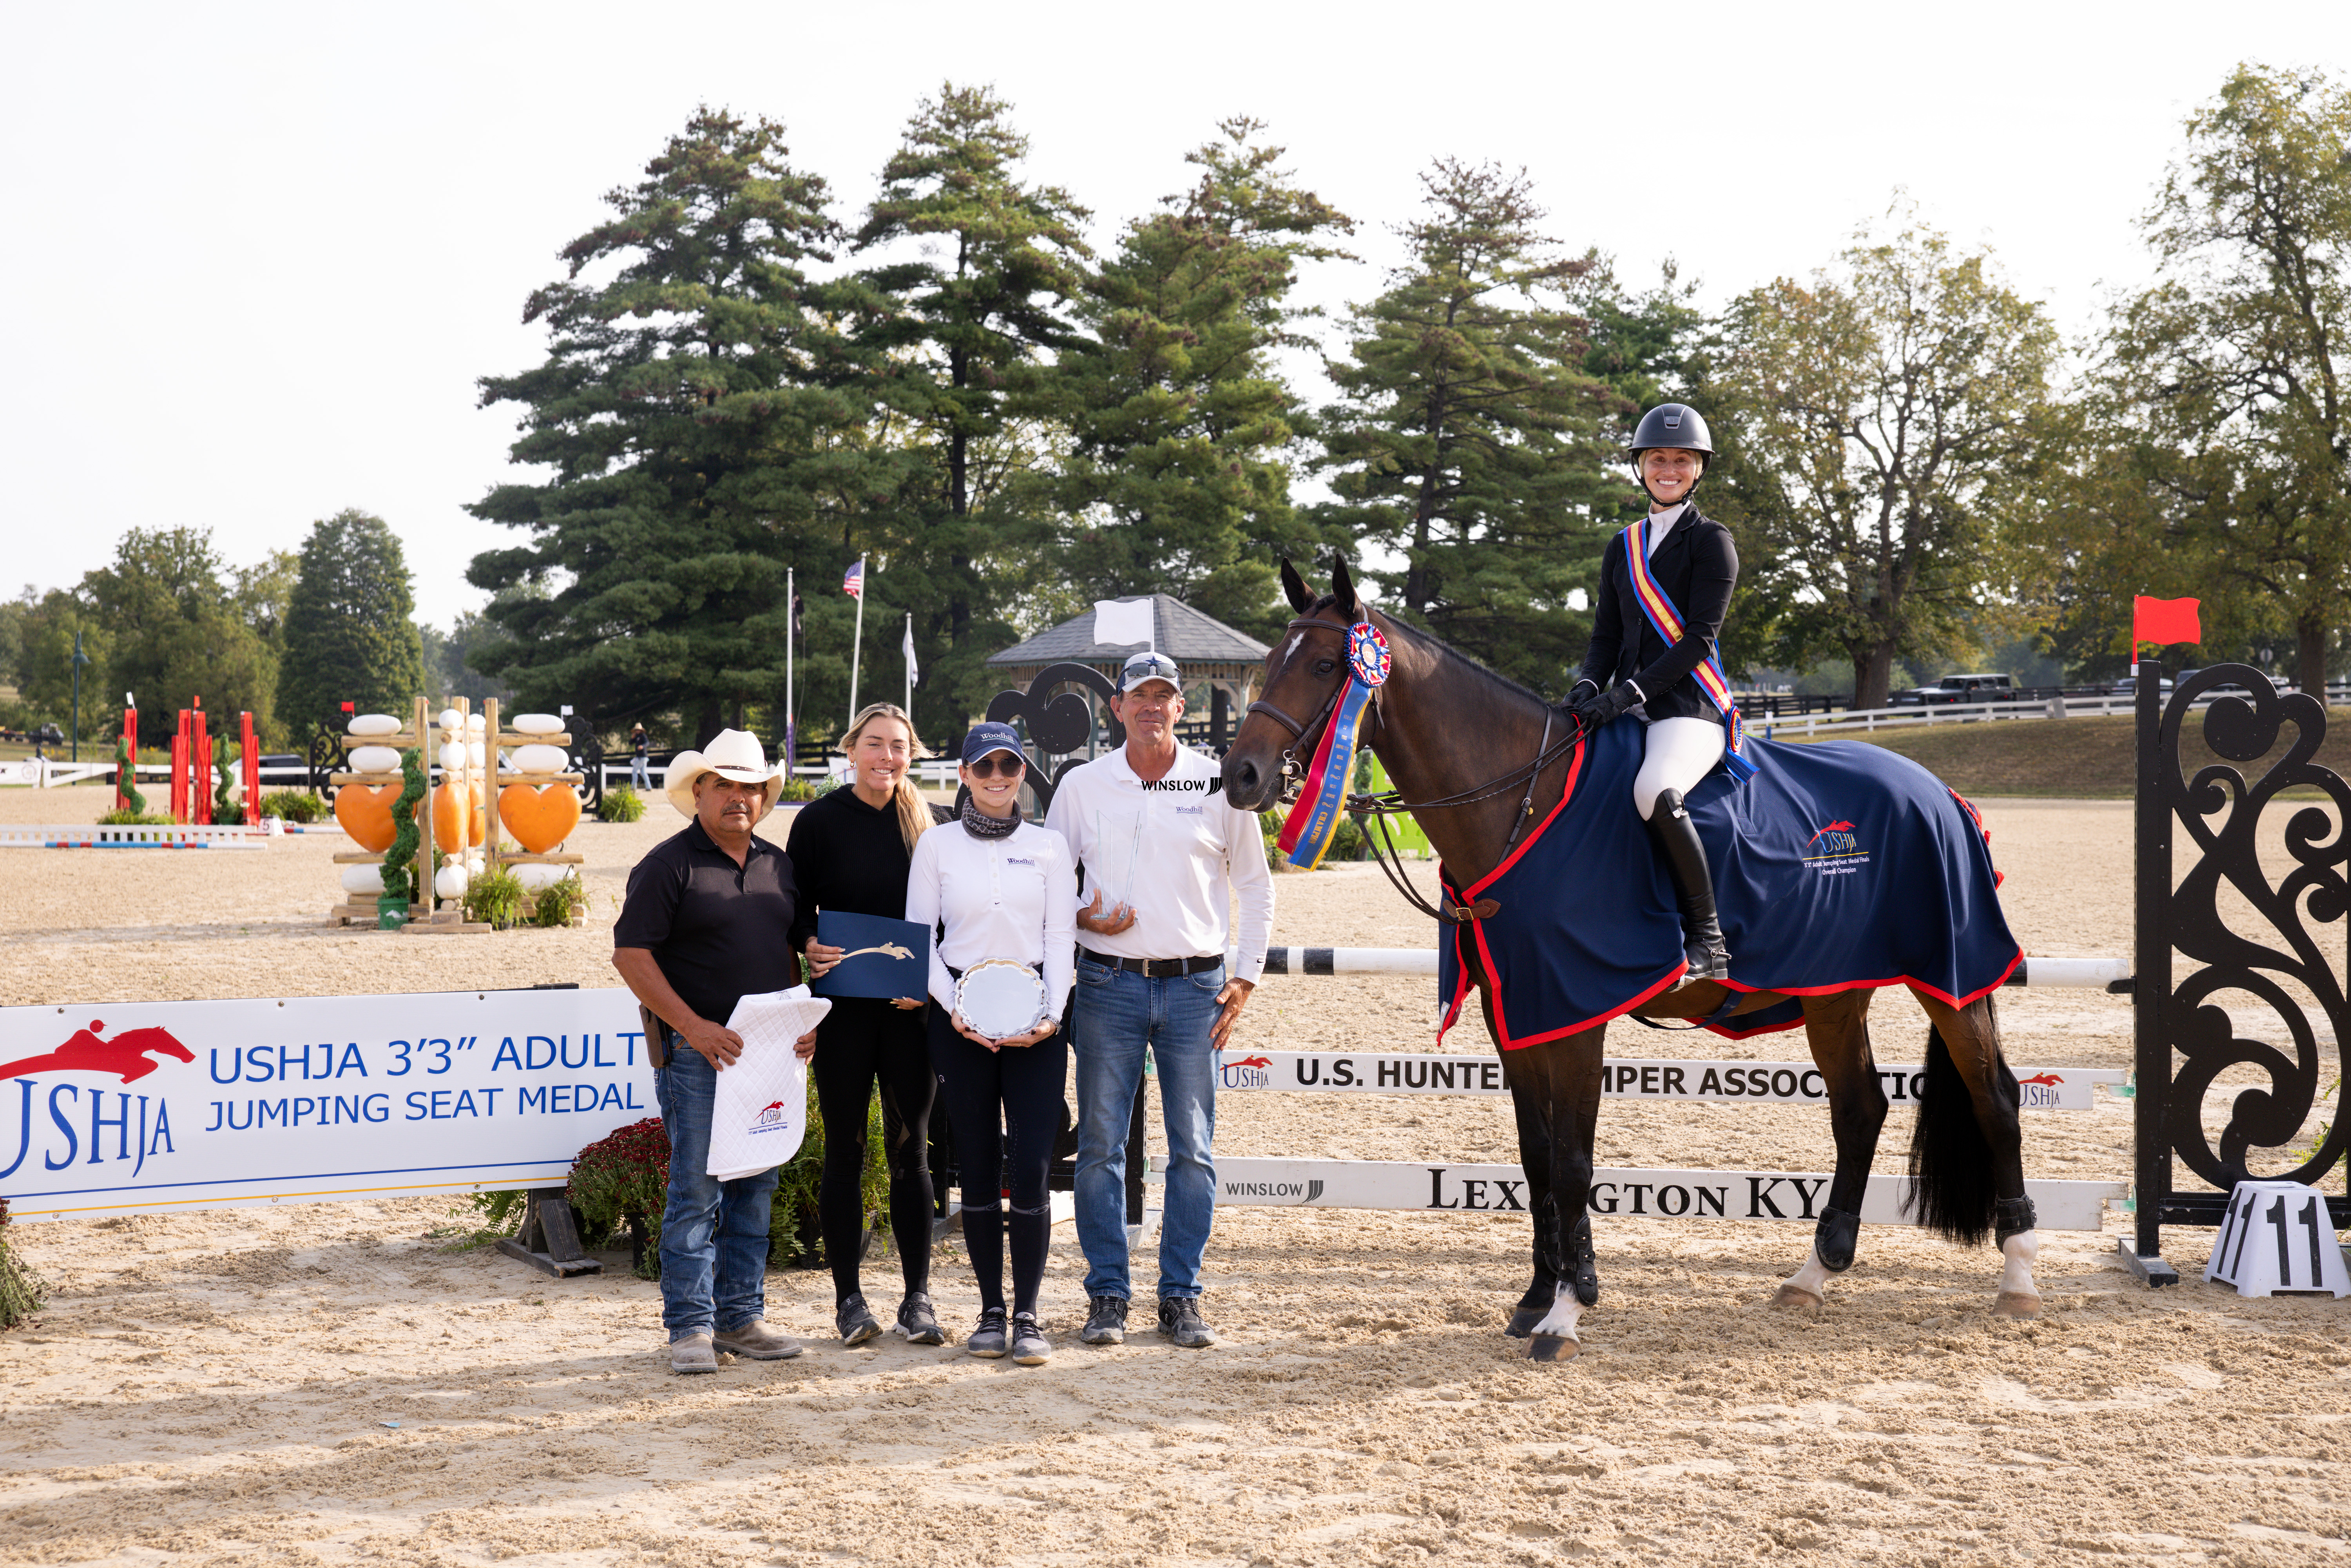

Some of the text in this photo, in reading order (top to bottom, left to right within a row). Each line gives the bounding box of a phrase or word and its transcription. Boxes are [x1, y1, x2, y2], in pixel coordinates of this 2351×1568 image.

[980, 732, 1014, 742] Woodhill
[263, 819, 269, 831] 5
[1308, 811, 1328, 845] CHAMPION
[1815, 830, 1857, 853] USHJA
[211, 1043, 368, 1084] USHJA
[491, 1032, 645, 1072] ADULT
[1221, 1063, 1269, 1090] USHJA
[1297, 1058, 1363, 1086] U.S.
[1602, 1065, 1688, 1094] PER
[206, 1083, 644, 1132] JUMPING SEAT MEDAL
[761, 1109, 781, 1124] USHJA
[1226, 1182, 1303, 1196] WINSLOW
[1427, 1168, 1828, 1219] LEXGTON KY
[2217, 1188, 2257, 1280] 11
[2266, 1195, 2323, 1287] 11
